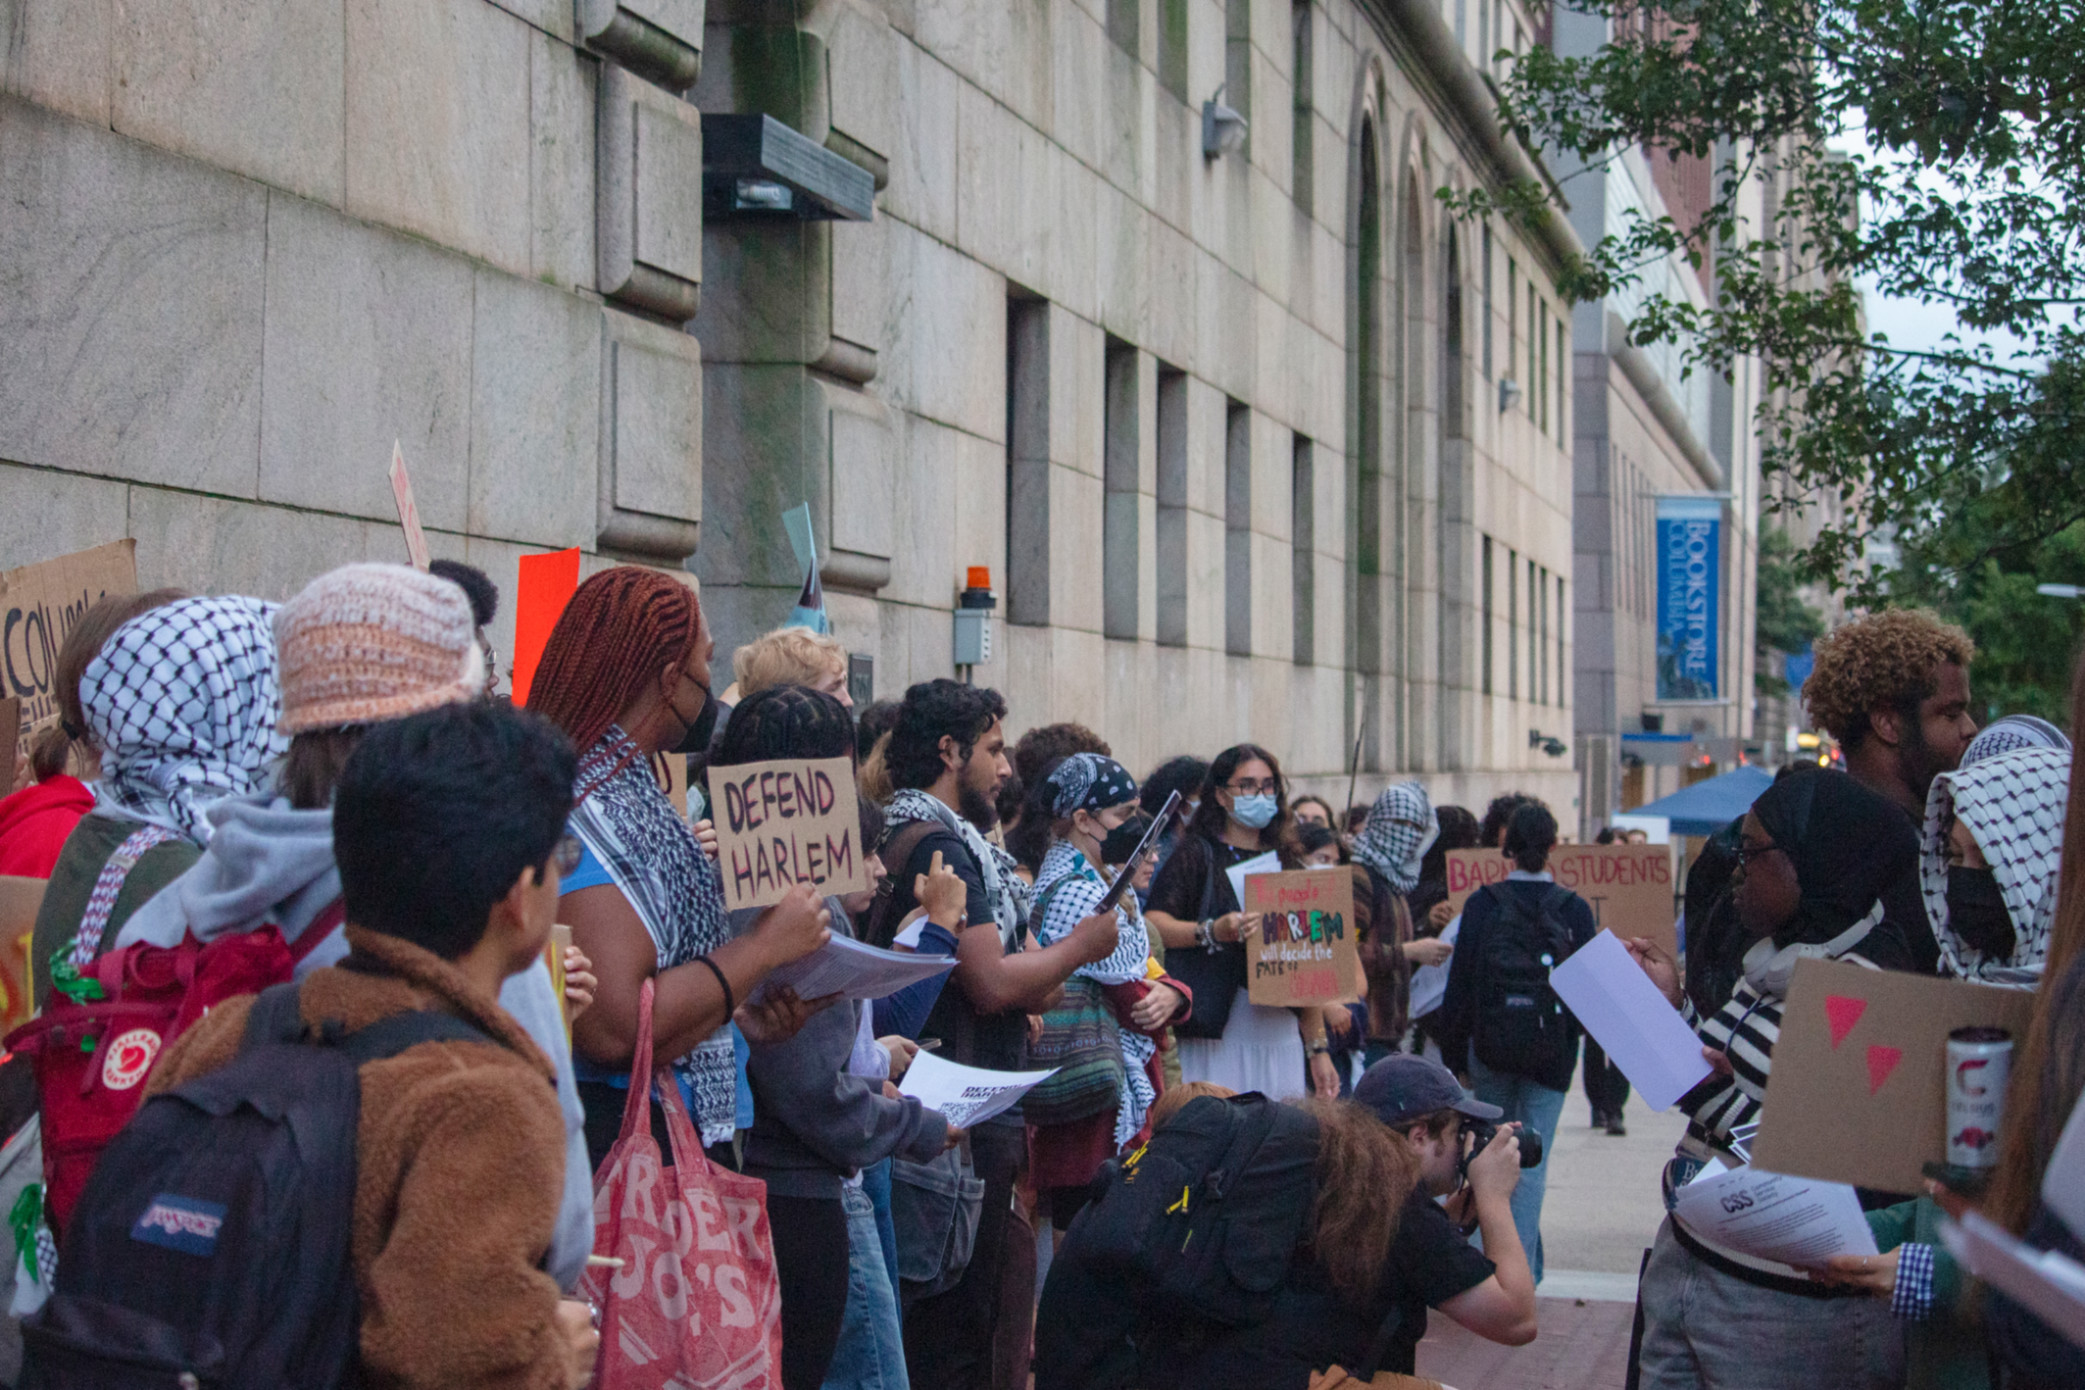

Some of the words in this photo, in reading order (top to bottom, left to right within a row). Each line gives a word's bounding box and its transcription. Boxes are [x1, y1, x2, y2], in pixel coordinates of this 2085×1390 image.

[1668, 520, 1686, 630] COLUMBIA
[1686, 520, 1711, 674] BOOKSTORE
[723, 766, 835, 835] DEFEND
[731, 828, 853, 901] HARLEM
[1560, 854, 1670, 887] STUDENTS
[1260, 942, 1278, 961] will
[1279, 941, 1313, 961] decide
[1314, 942, 1333, 961] the
[1262, 909, 1344, 947] HARLEM
[1256, 961, 1285, 979] FATE
[1721, 1189, 1754, 1214] CSS
[609, 1234, 757, 1329] JO'S
